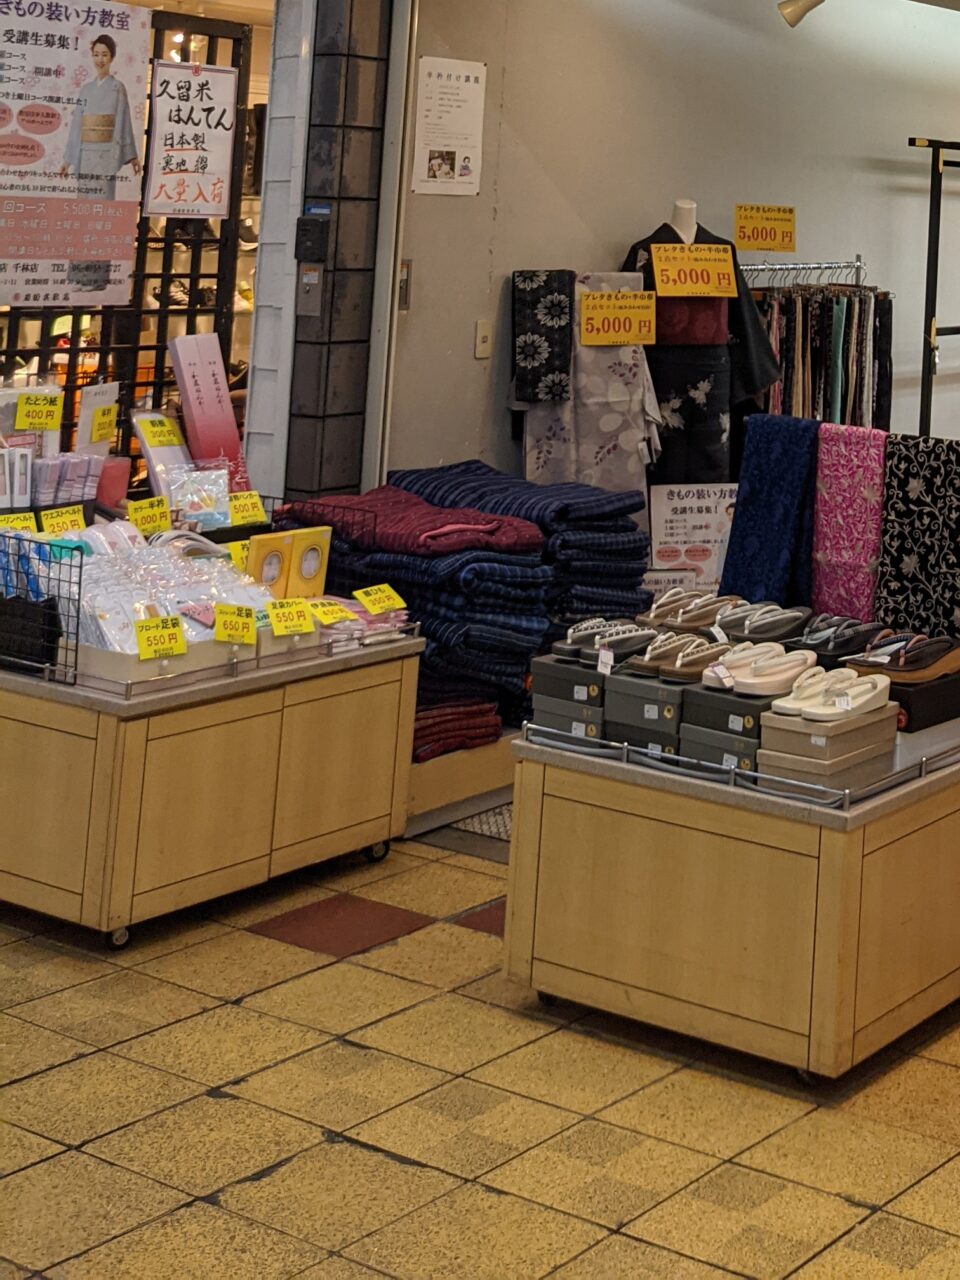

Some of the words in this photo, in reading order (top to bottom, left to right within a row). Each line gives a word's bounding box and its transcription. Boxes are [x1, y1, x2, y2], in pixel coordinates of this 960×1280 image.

[156, 79, 213, 101] 久留米
[168, 104, 234, 131] はんてん
[163, 131, 208, 151] 日本製
[154, 177, 224, 203] 大量入荷
[51, 263, 67, 273] TEL
[660, 268, 711, 286] 5,000
[585, 316, 633, 335] 5,000
[24, 396, 58, 407] たとう紙
